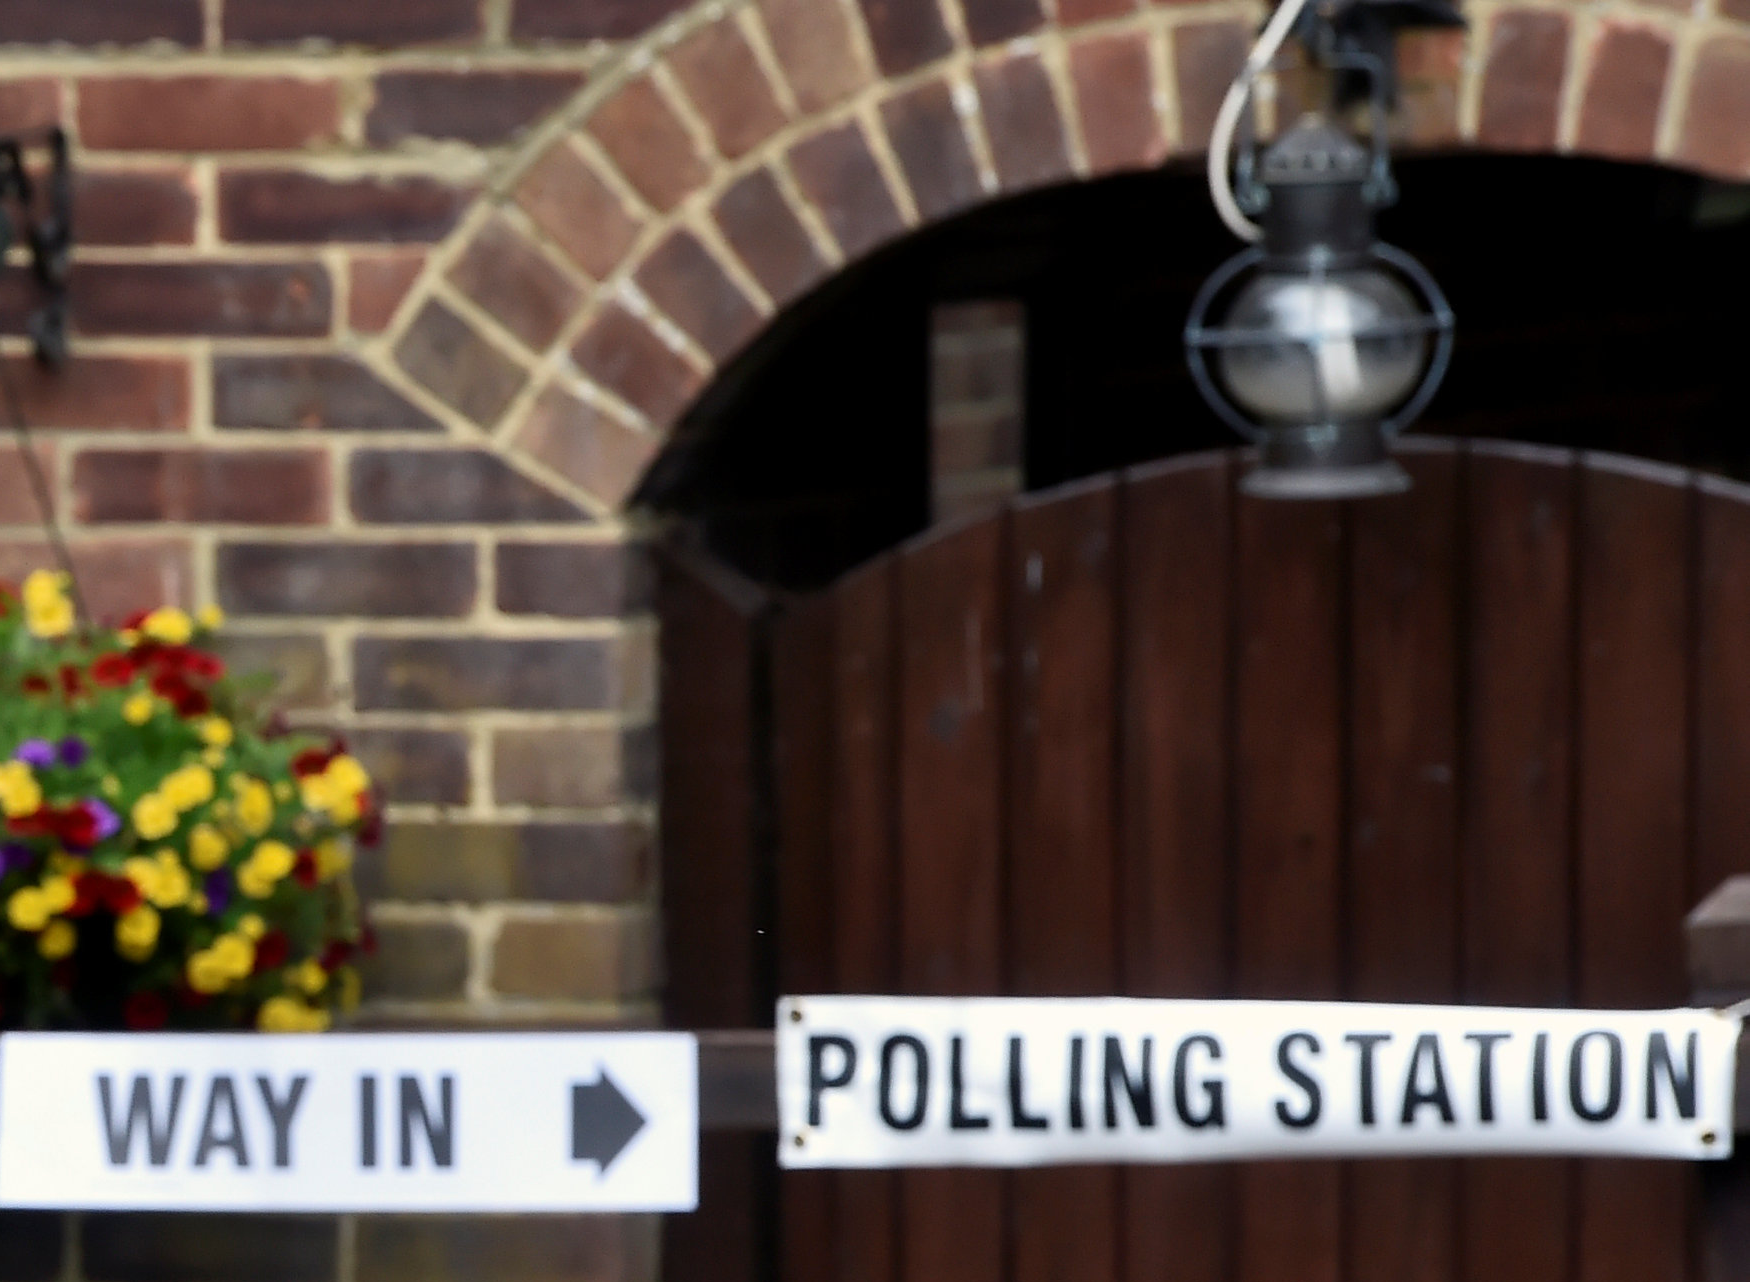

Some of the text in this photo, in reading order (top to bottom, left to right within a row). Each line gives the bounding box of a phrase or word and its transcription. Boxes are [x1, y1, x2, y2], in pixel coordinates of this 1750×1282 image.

[95, 1073, 454, 1169] WAY IN
[808, 1030, 1698, 1131] POLLING STATION
